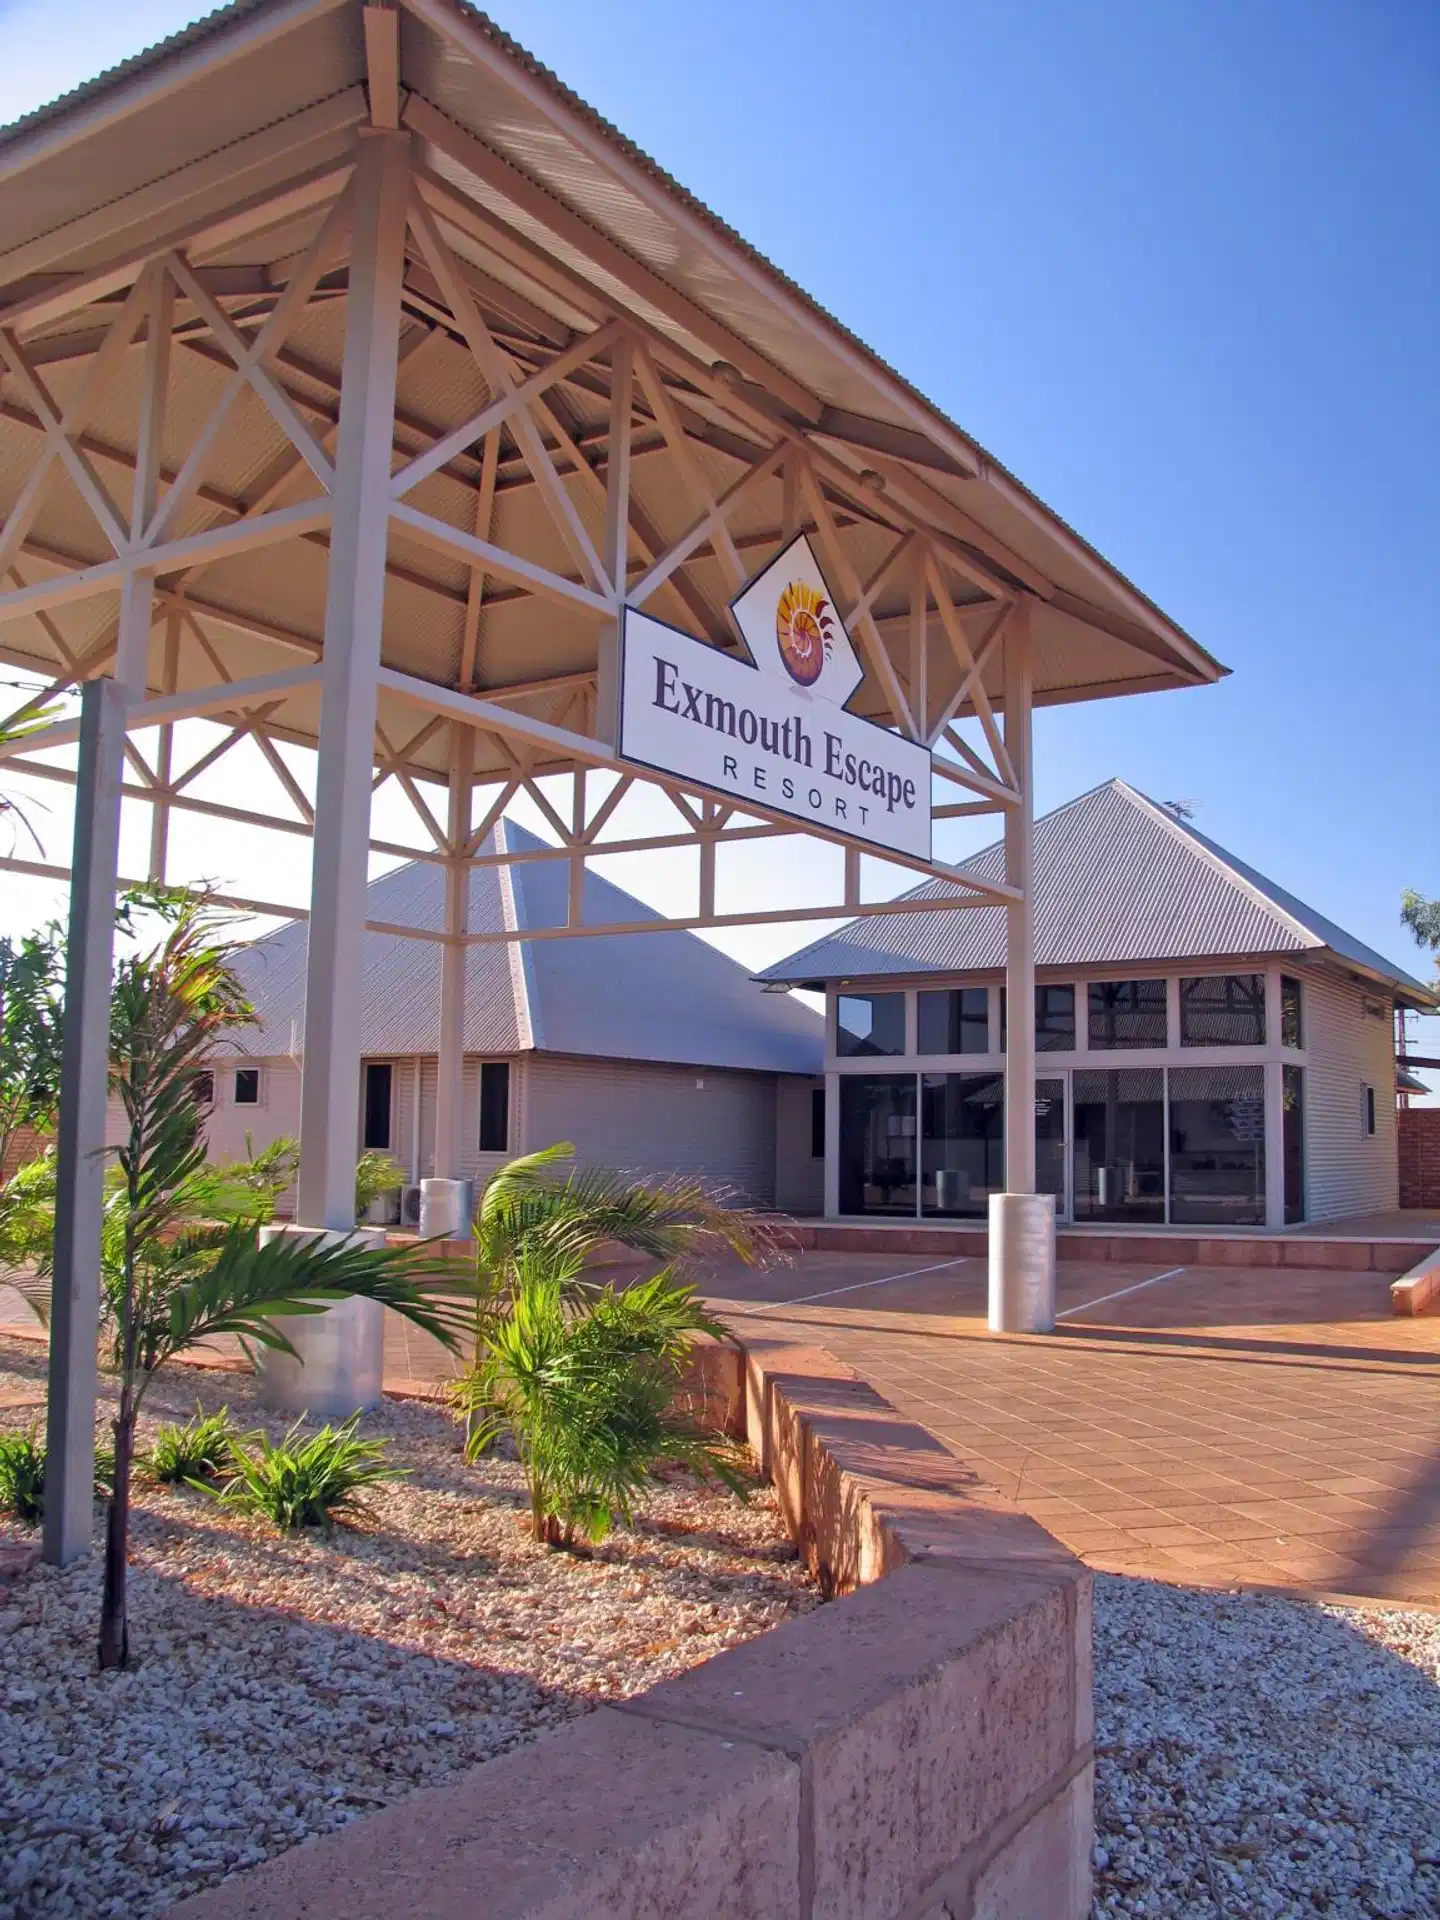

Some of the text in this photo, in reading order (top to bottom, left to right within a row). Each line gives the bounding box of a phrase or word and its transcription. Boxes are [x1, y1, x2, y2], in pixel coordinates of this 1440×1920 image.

[652, 656, 916, 813] Exmouth Escape
[723, 755, 868, 825] RESORT
